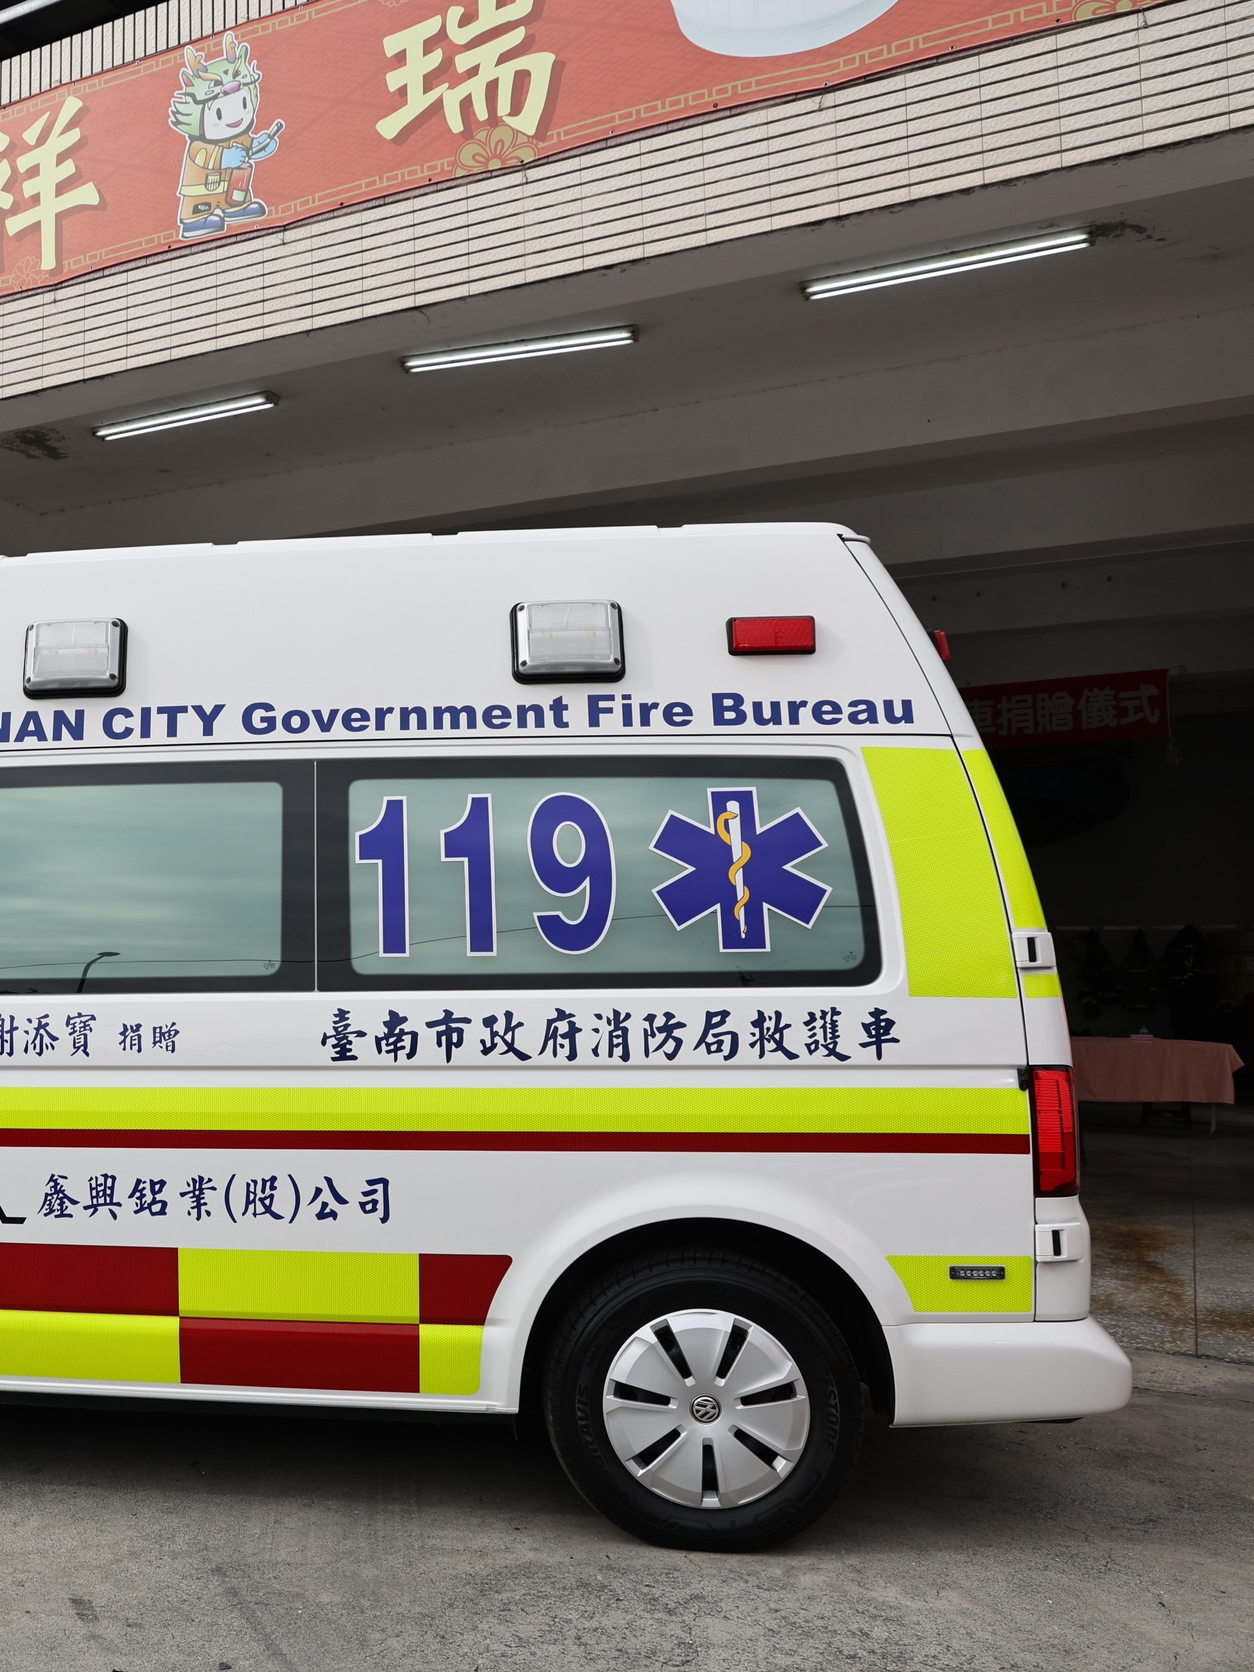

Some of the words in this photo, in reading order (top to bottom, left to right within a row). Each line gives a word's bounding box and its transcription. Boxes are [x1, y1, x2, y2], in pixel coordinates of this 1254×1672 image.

[375, 0, 557, 140] 瑞
[101, 703, 227, 740] CITY
[242, 694, 570, 737] Government
[587, 693, 694, 728] Fire
[711, 692, 914, 726] Bureau
[967, 683, 1161, 737] 車捐贈儀式
[354, 791, 617, 958] 119
[118, 1021, 180, 1054] 捐贈
[320, 1006, 901, 1063] 臺南市政府消防局救護車
[37, 1172, 391, 1225] 鑫興鋁業(股)公司
